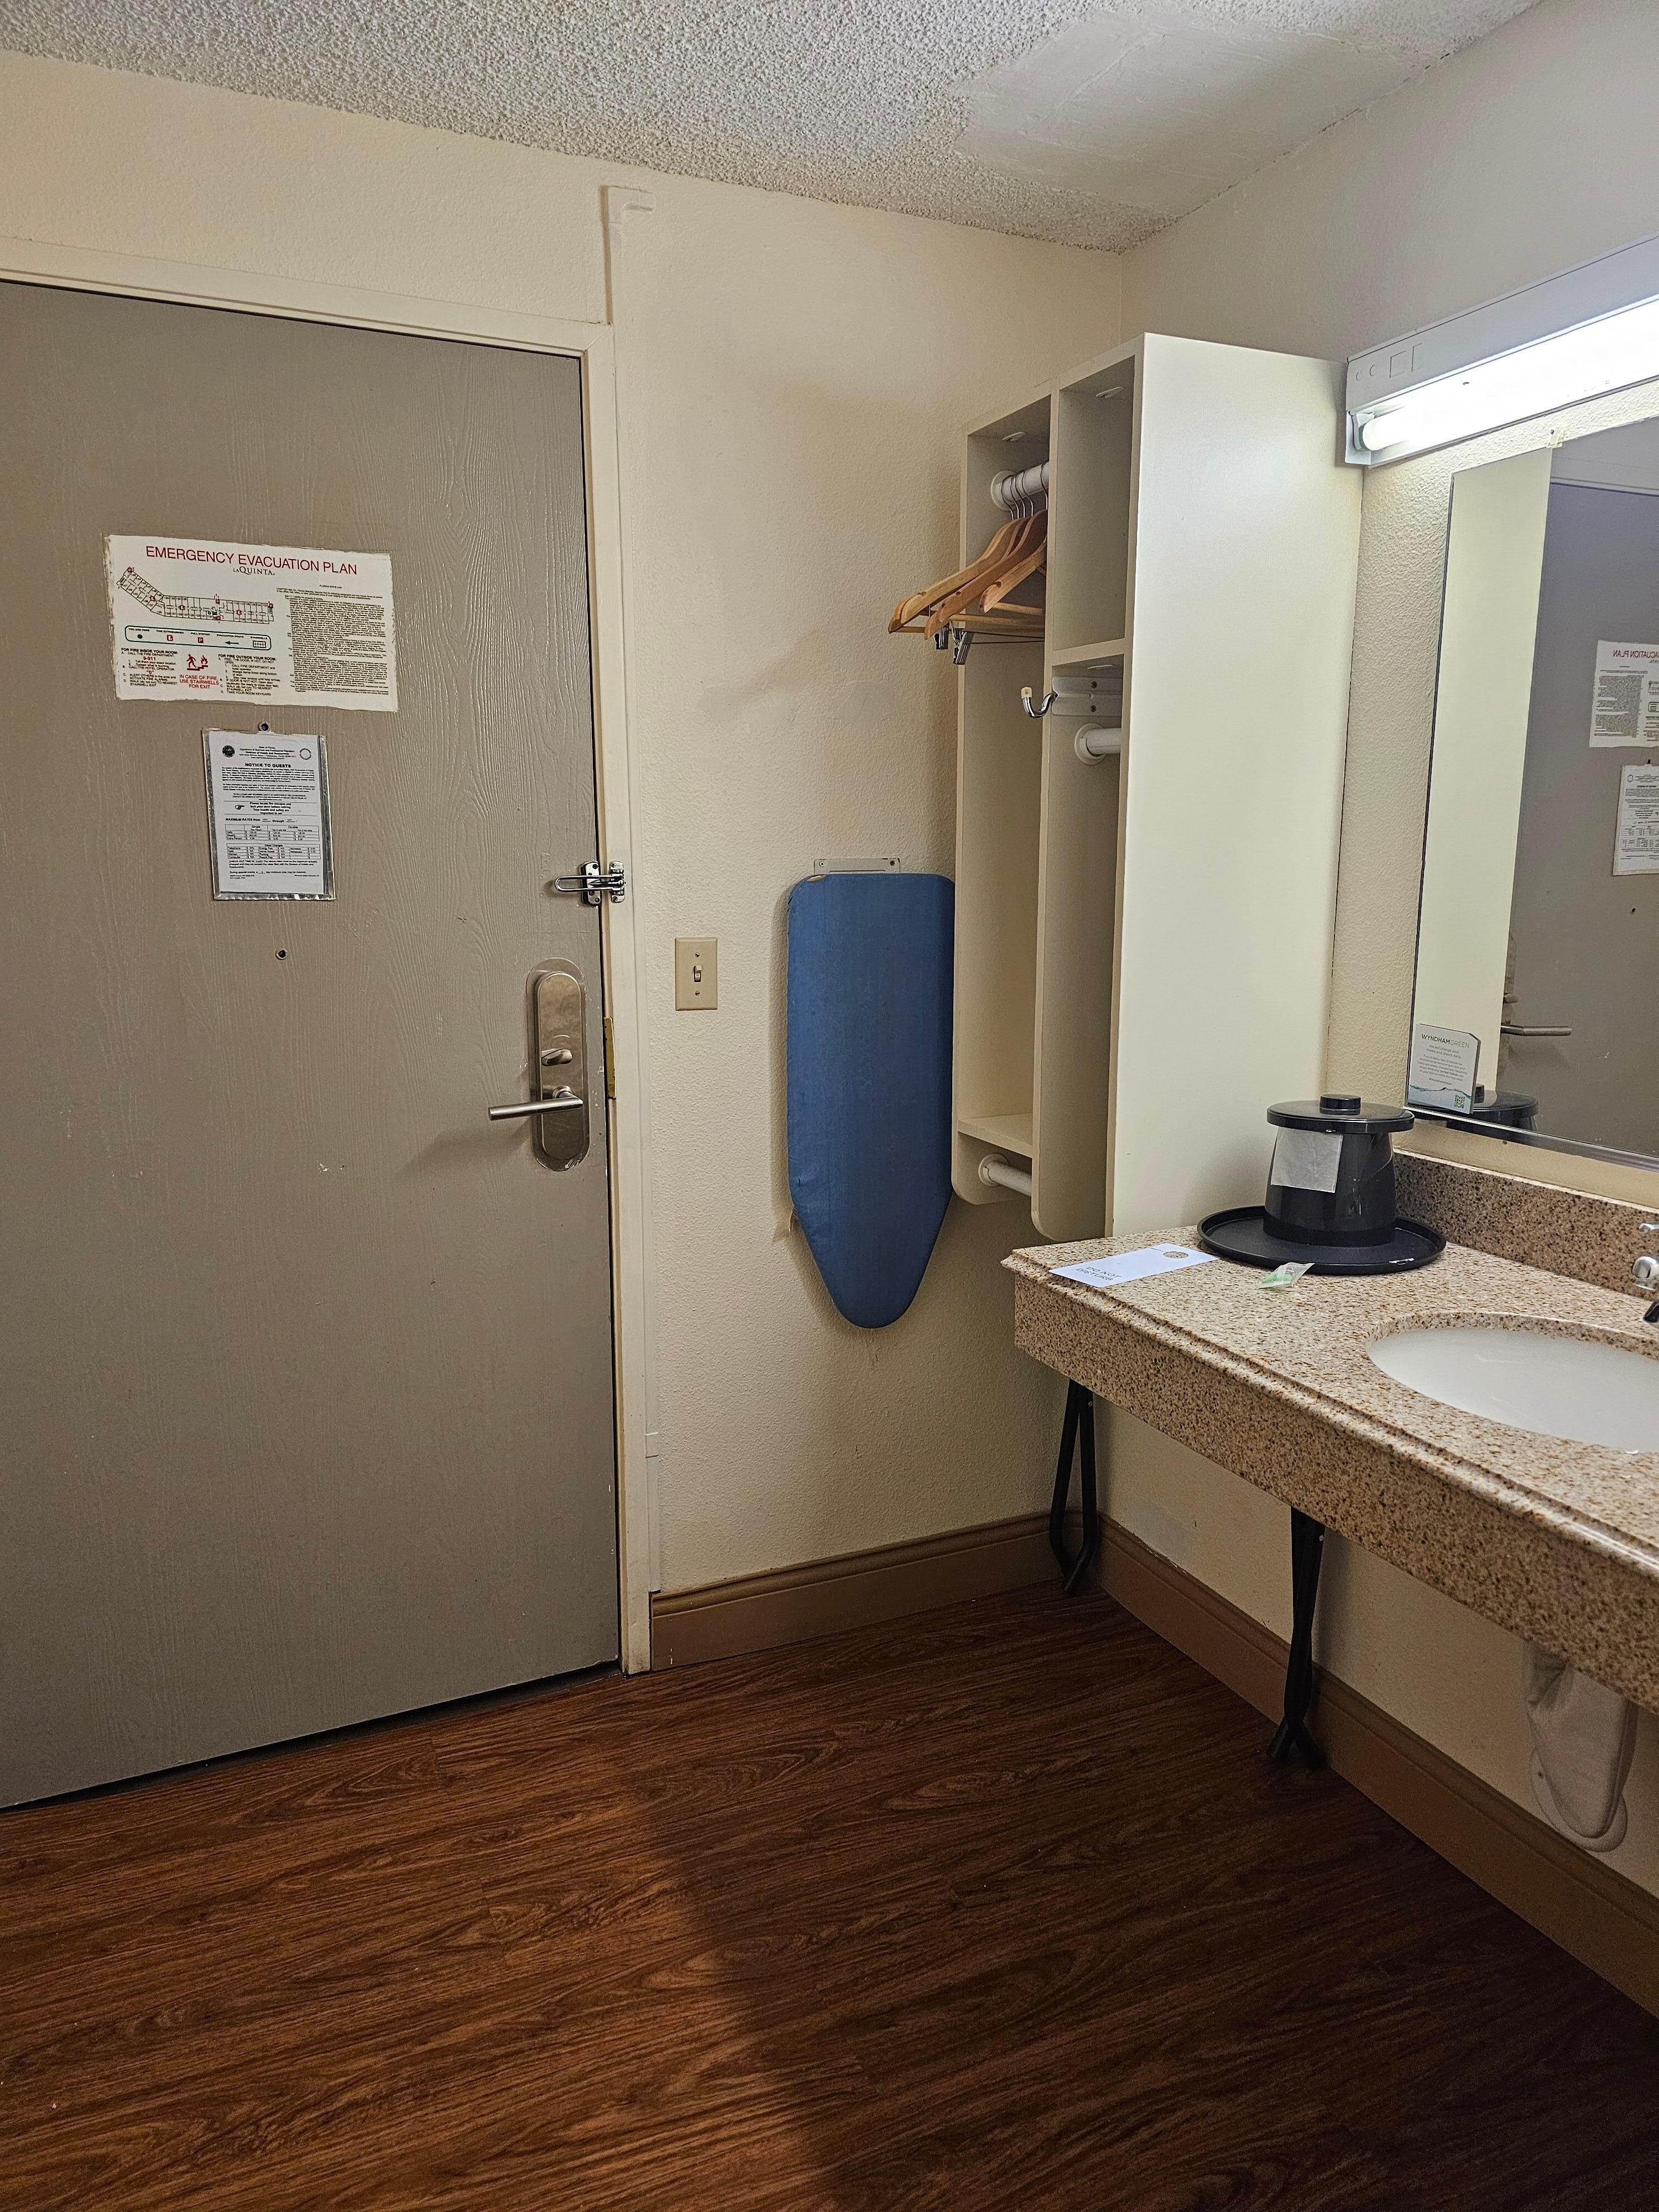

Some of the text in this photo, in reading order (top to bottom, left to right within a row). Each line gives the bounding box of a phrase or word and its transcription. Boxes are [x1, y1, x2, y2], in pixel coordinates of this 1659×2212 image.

[146, 546, 357, 575] EMERGENCY EVACUATION PLAN
[1422, 1034, 1469, 1048] WYNDHAMGREEN
[1076, 1269, 1113, 1281] DISTURB
[1102, 1270, 1122, 1279] NOT
